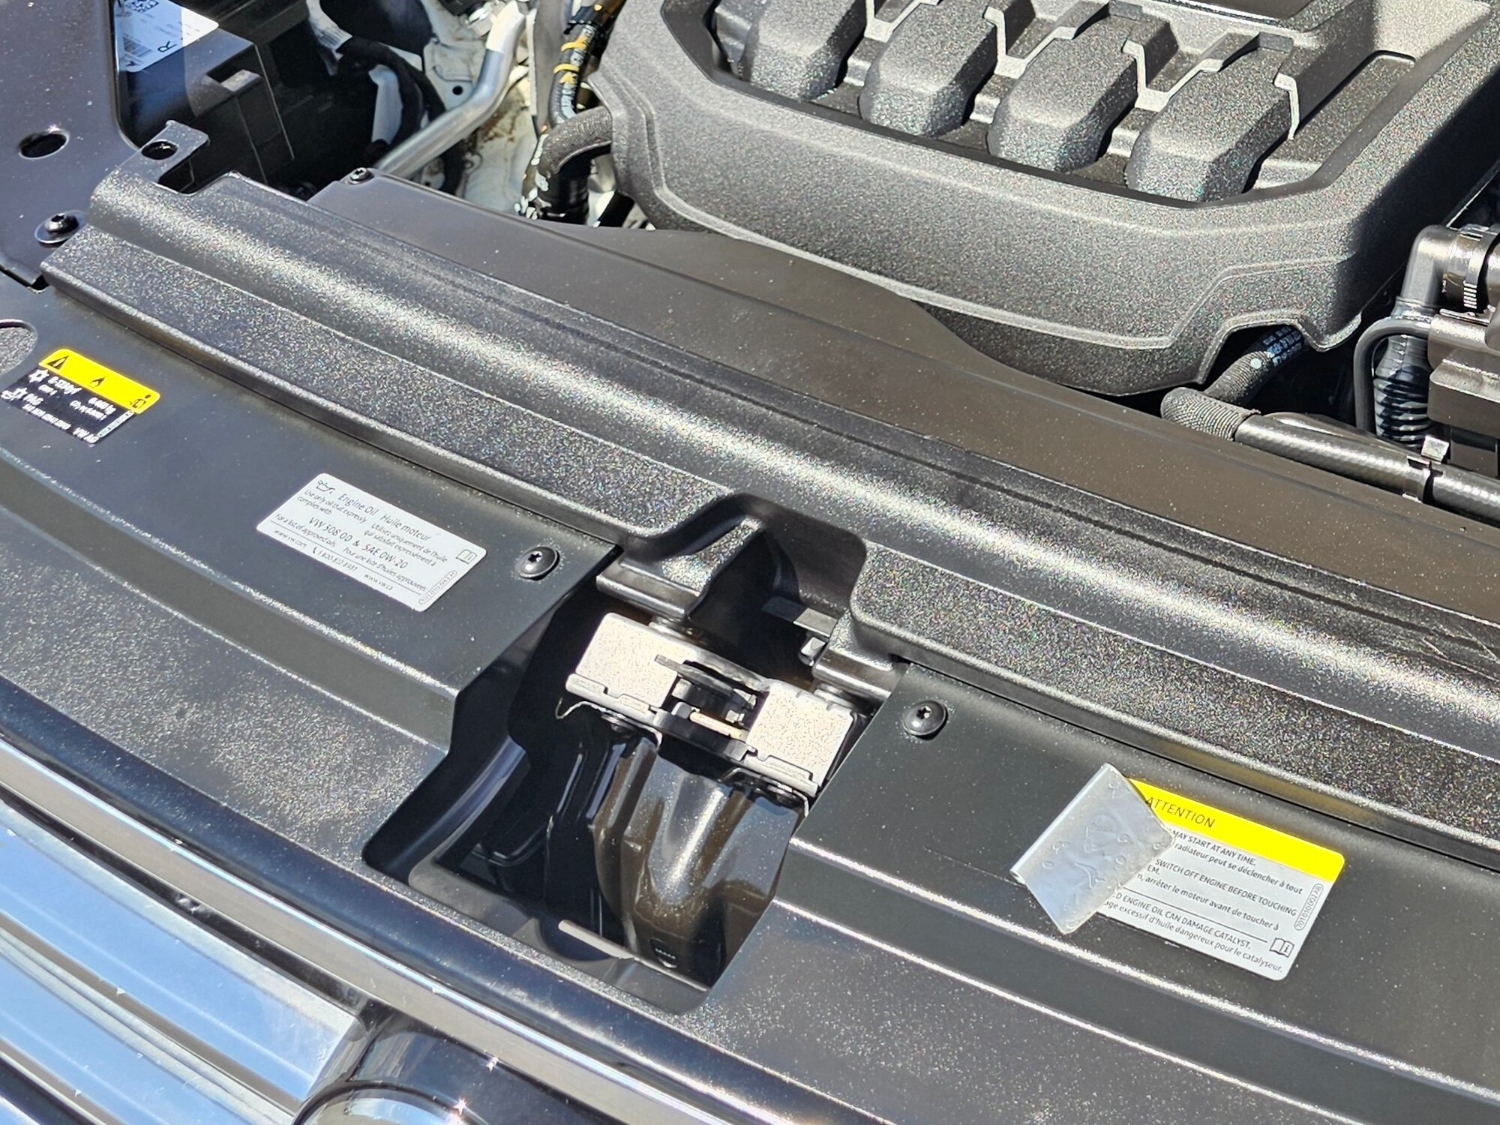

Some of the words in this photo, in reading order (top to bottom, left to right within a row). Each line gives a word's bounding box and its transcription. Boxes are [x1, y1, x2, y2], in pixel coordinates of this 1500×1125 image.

[338, 493, 365, 510] Engine
[364, 506, 379, 516] Oil
[380, 514, 402, 528] Huile
[400, 525, 431, 541] moteur
[309, 517, 326, 528] VW
[322, 524, 341, 536] 508
[339, 532, 353, 542] 00
[362, 544, 381, 556] SAE
[379, 551, 408, 569] 0W-20
[1145, 797, 1216, 828] ATTENTION
[1174, 843, 1209, 859] radiateur
[1208, 856, 1227, 867] peut
[1237, 865, 1278, 885] déclencher
[1285, 883, 1303, 894] tout
[1188, 836, 1211, 848] START
[1210, 844, 1220, 852] AT
[1220, 848, 1236, 858] ANY
[1237, 853, 1256, 866] TIME.
[1145, 877, 1171, 890] arrêter
[1172, 885, 1180, 893] le
[1180, 890, 1209, 904] moteur
[1209, 900, 1231, 913] avant
[1231, 908, 1242, 917] de
[1242, 912, 1273, 928] toucher
[1273, 923, 1279, 931] à
[1155, 859, 1184, 874] SWITCH
[1183, 869, 1200, 879] OFF
[1199, 874, 1228, 890] ENGINE
[1227, 885, 1258, 902] BEFORE
[1258, 896, 1297, 916] TOUCHING
[1119, 906, 1149, 920] excessif
[1148, 916, 1174, 931] d'huile
[1174, 926, 1214, 946] dangereux
[1214, 942, 1234, 953] pour
[1233, 947, 1242, 956] le
[1242, 953, 1282, 973] catalyseur.
[1122, 895, 1151, 911] ENGINE
[1151, 906, 1163, 916] OIL
[1165, 911, 1181, 922] CAN
[1181, 917, 1214, 934] DAMAGE
[1214, 930, 1251, 950] CATALYST.
